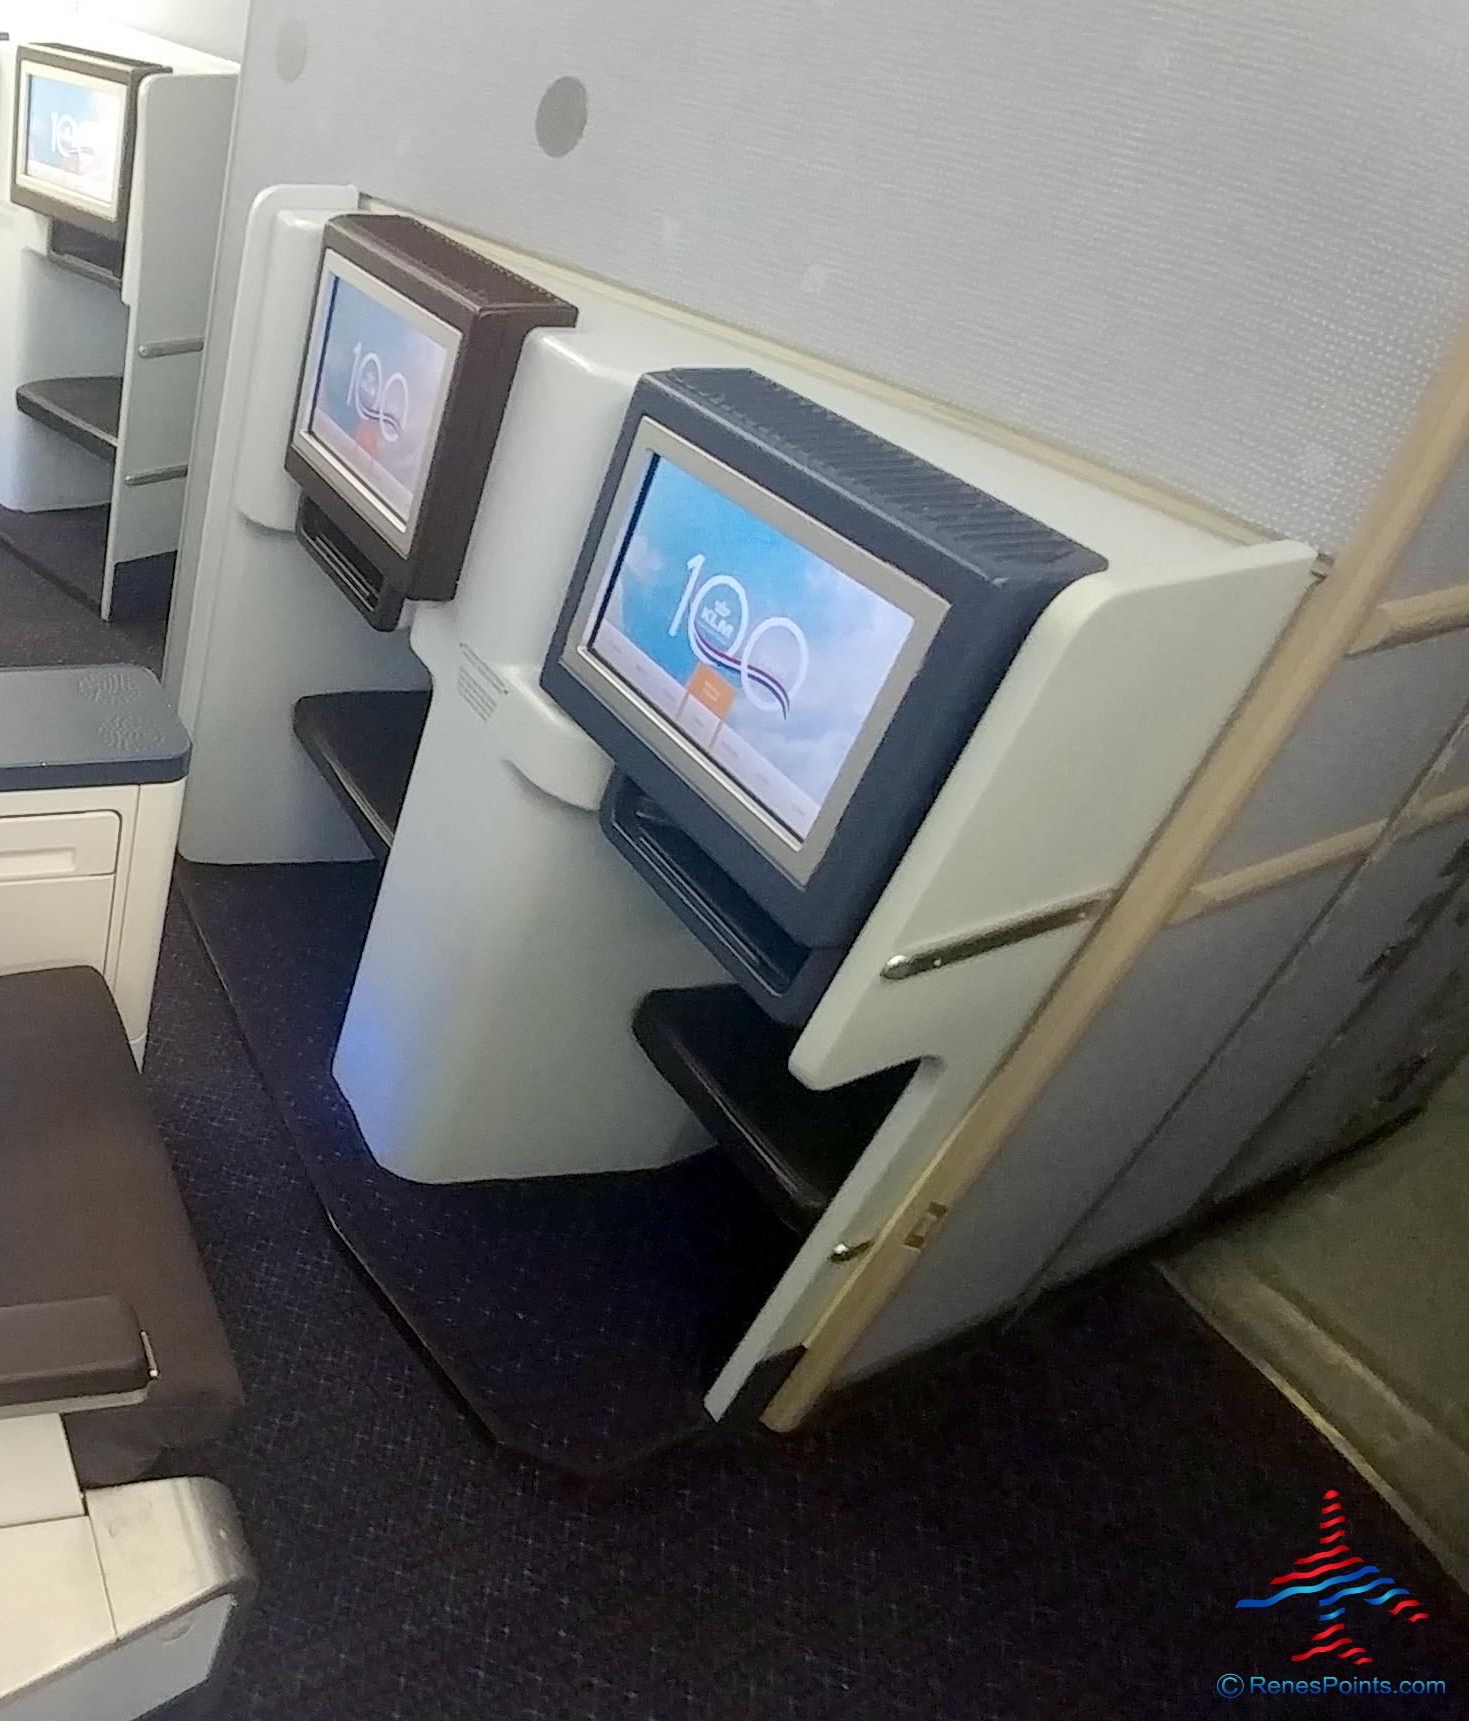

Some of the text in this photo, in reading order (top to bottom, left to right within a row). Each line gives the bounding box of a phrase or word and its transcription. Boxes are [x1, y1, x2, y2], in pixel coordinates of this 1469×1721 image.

[346, 341, 409, 442] 100
[668, 554, 809, 712] 100
[700, 605, 735, 639] KLM
